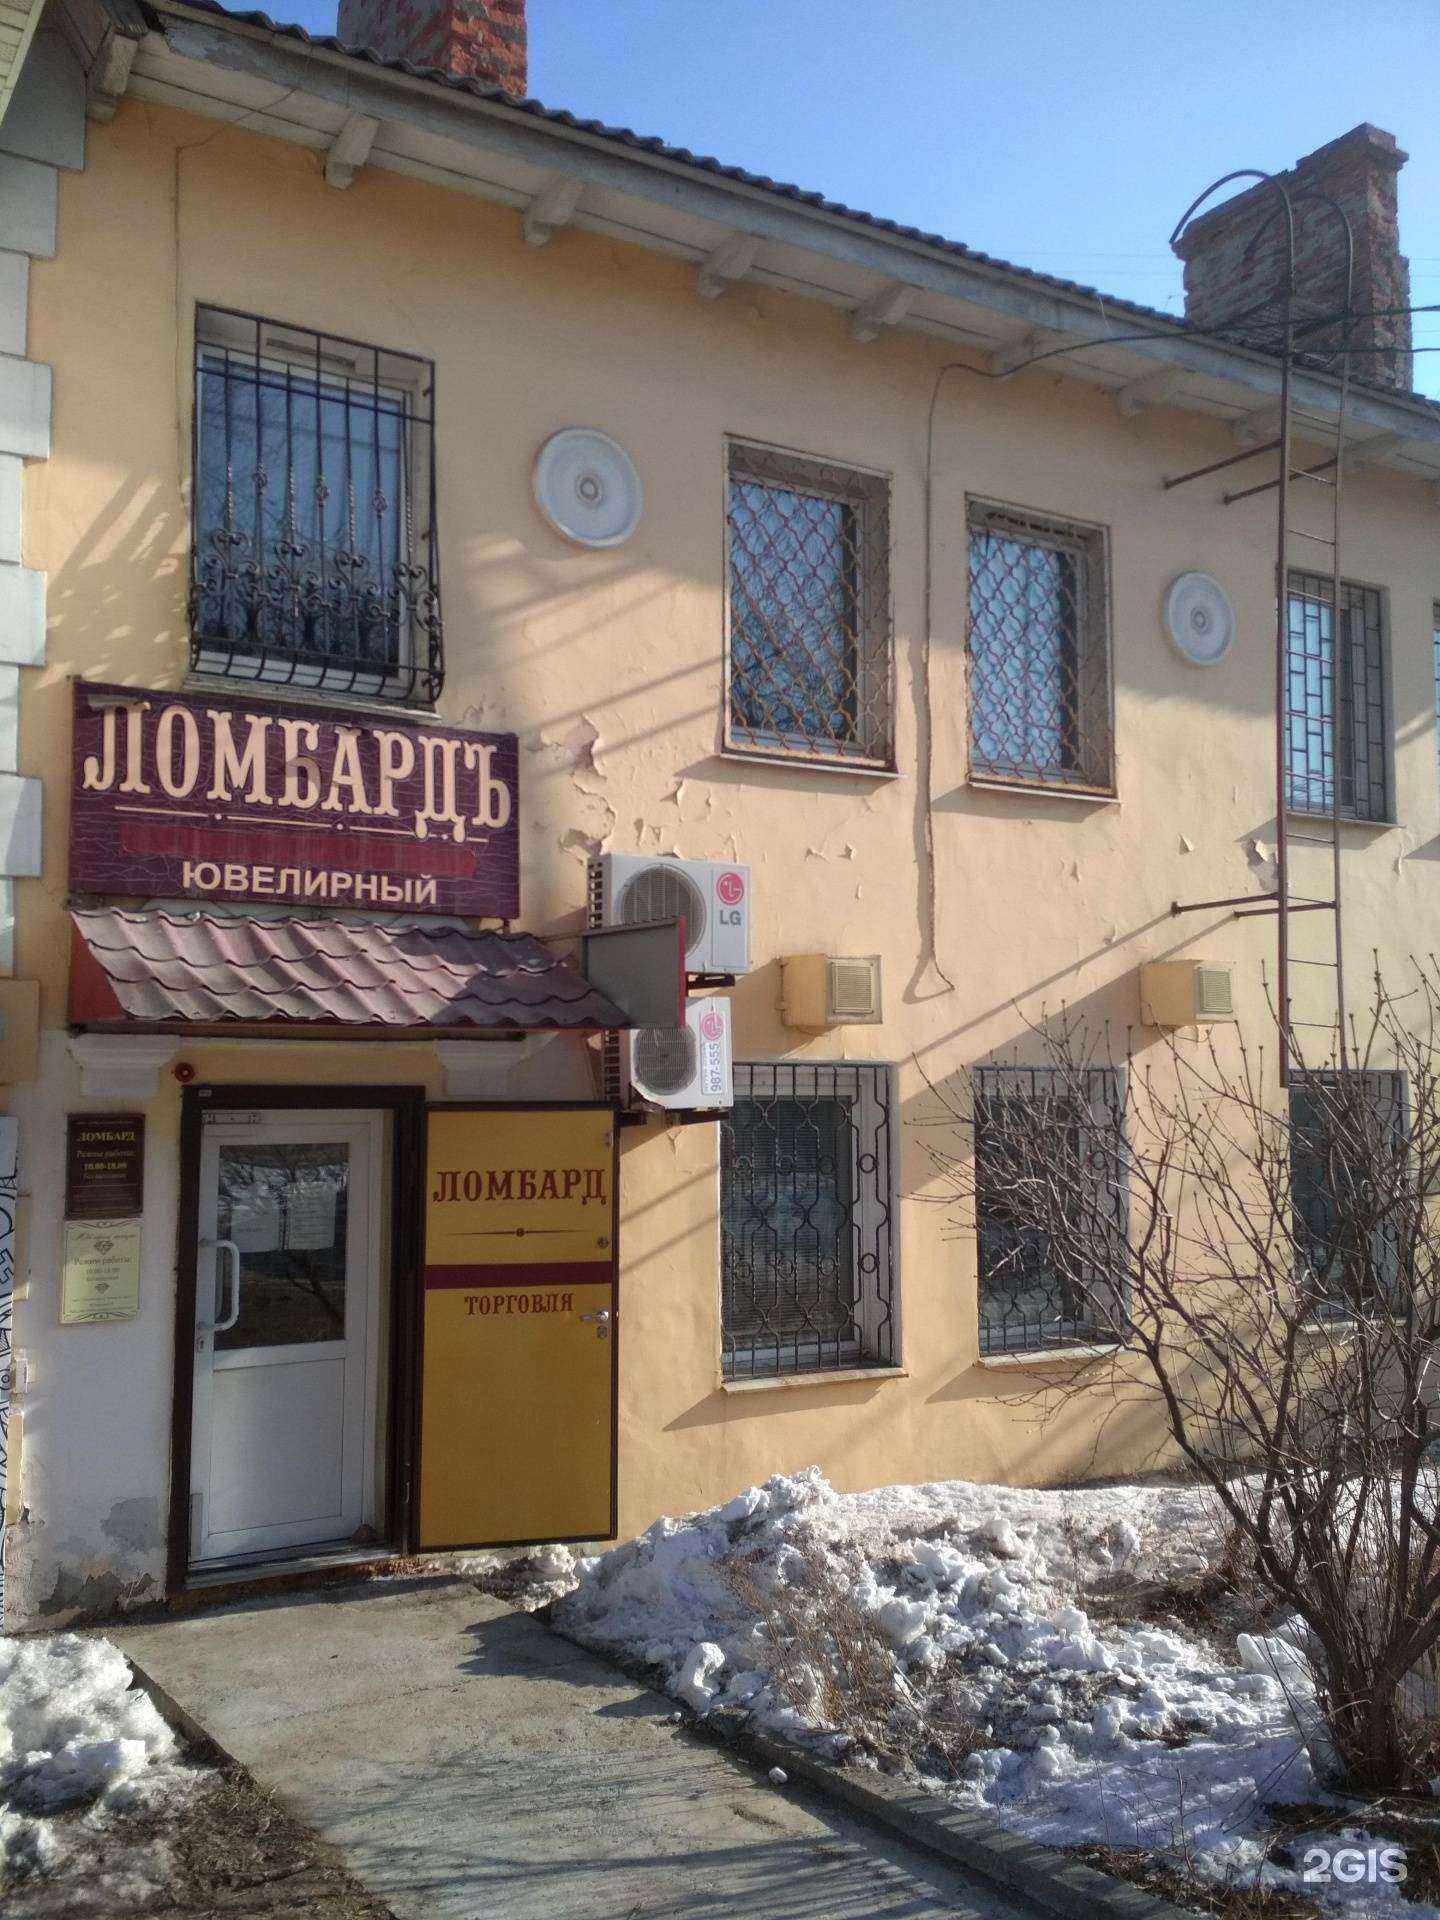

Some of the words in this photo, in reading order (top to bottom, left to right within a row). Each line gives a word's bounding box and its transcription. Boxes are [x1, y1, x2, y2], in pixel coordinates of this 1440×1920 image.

[82, 701, 512, 844] ЛОМБАРДЪ
[183, 860, 437, 905] ЮВЕЛИРНЫЙ
[719, 911, 742, 926] LG
[709, 1043, 722, 1092] 987-555
[432, 1168, 607, 1206] ЛОМБАРД
[464, 1293, 575, 1316] ТОРГОВЛЯ
